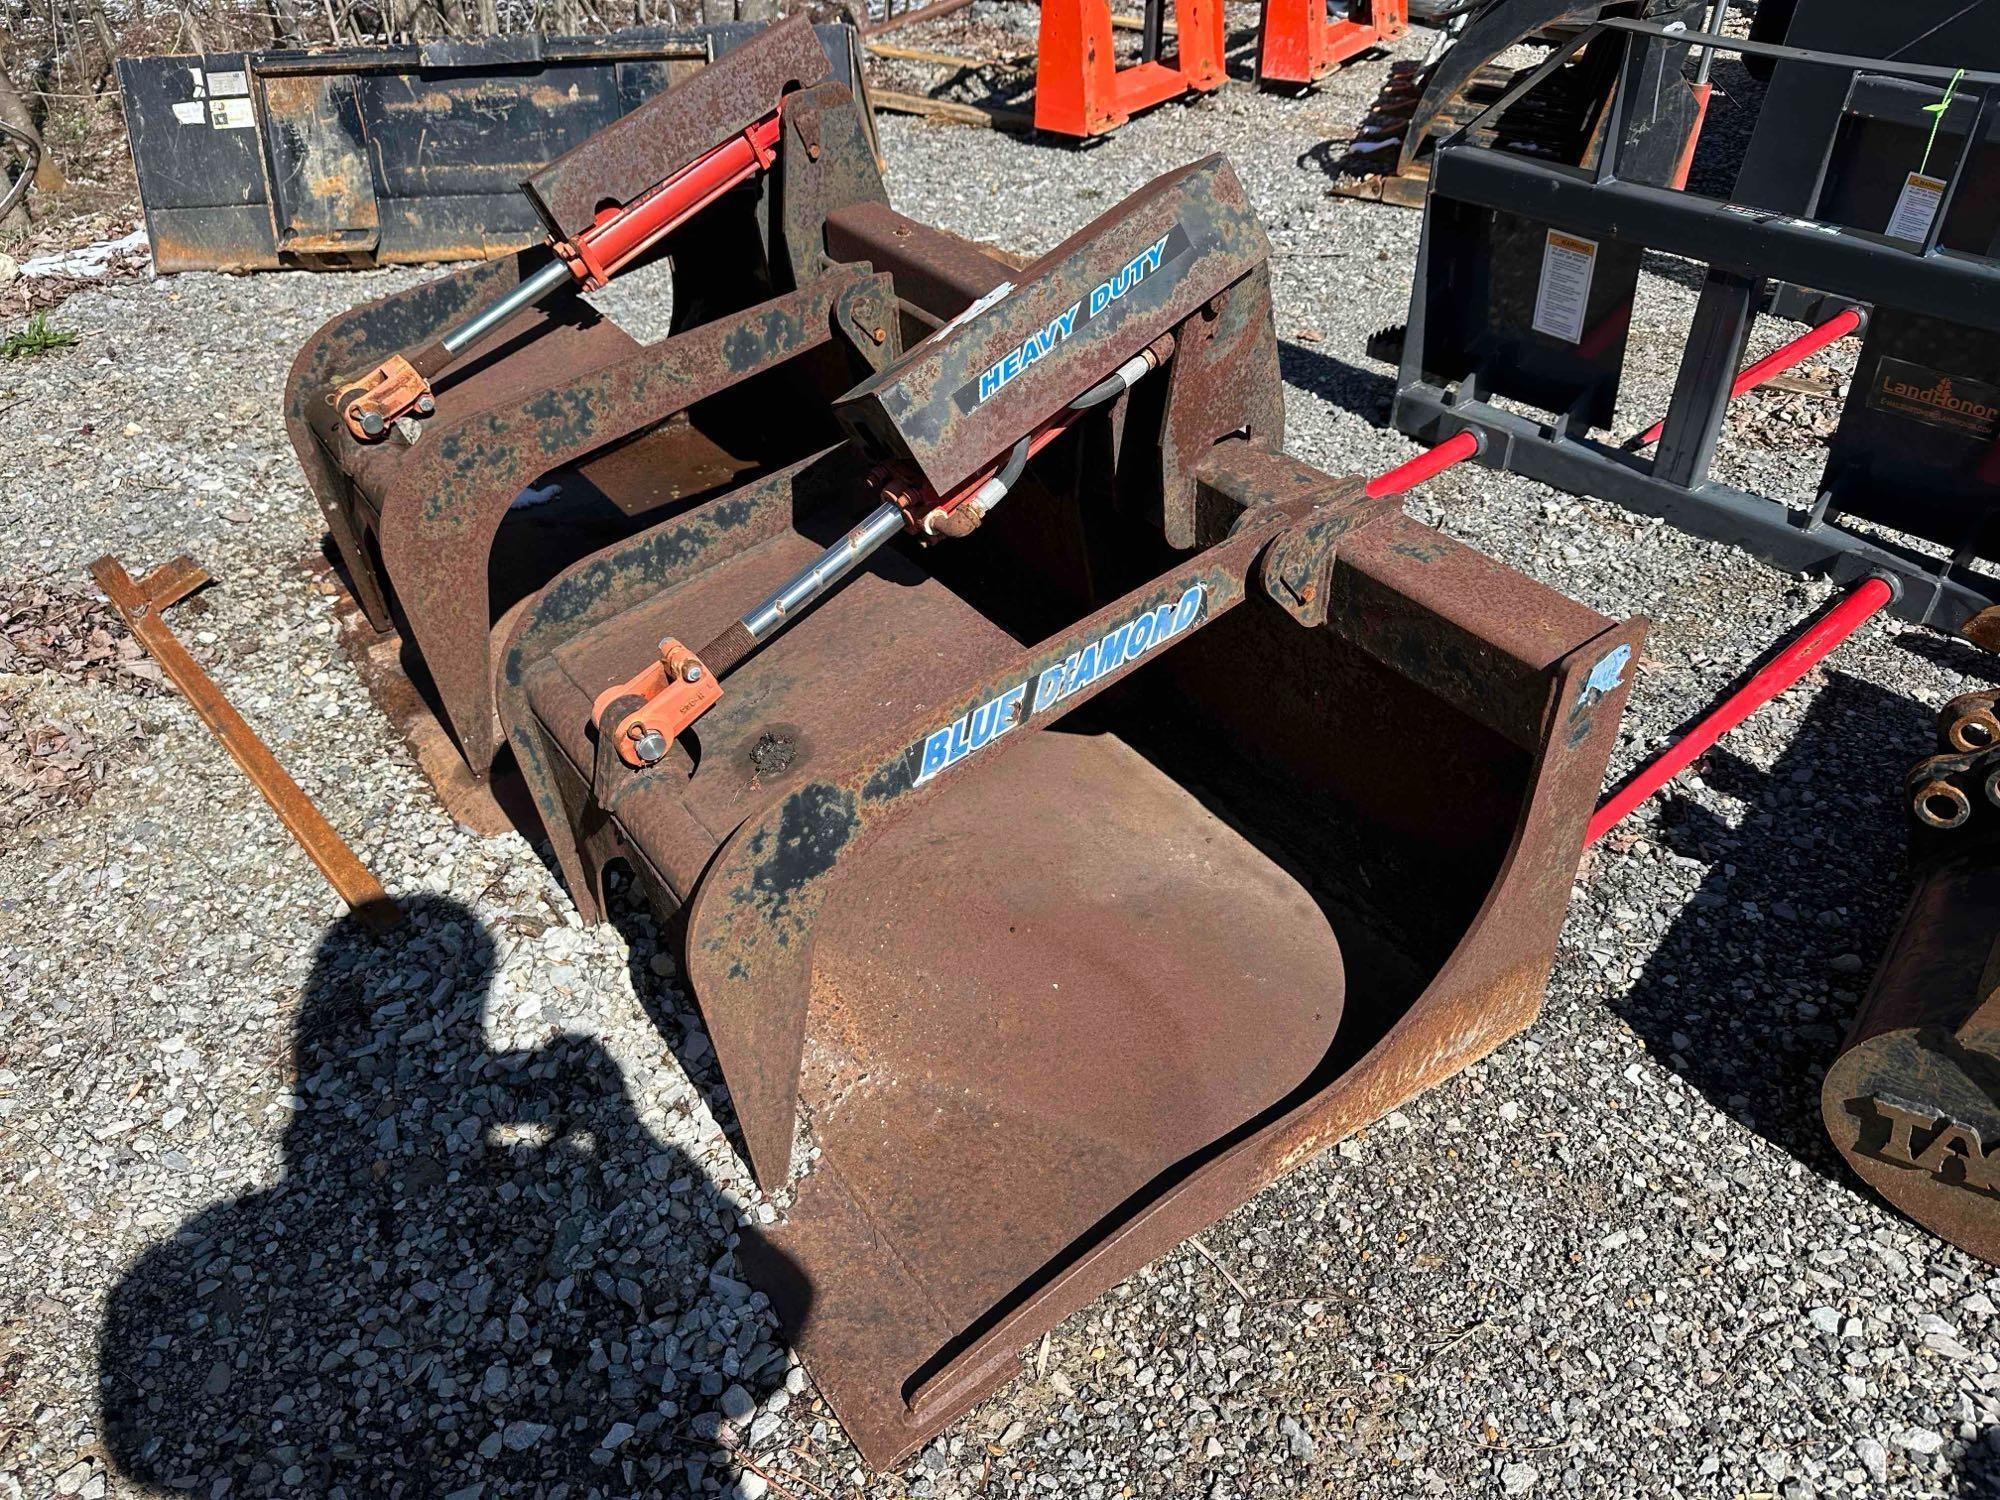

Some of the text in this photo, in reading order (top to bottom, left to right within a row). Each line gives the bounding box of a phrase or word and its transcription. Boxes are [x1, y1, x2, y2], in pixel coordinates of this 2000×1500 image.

[979, 234, 1169, 403] HEAVY DUTY
[1882, 376, 1998, 418] LandHonor
[913, 586, 1206, 788] BLUE DIAMOND
